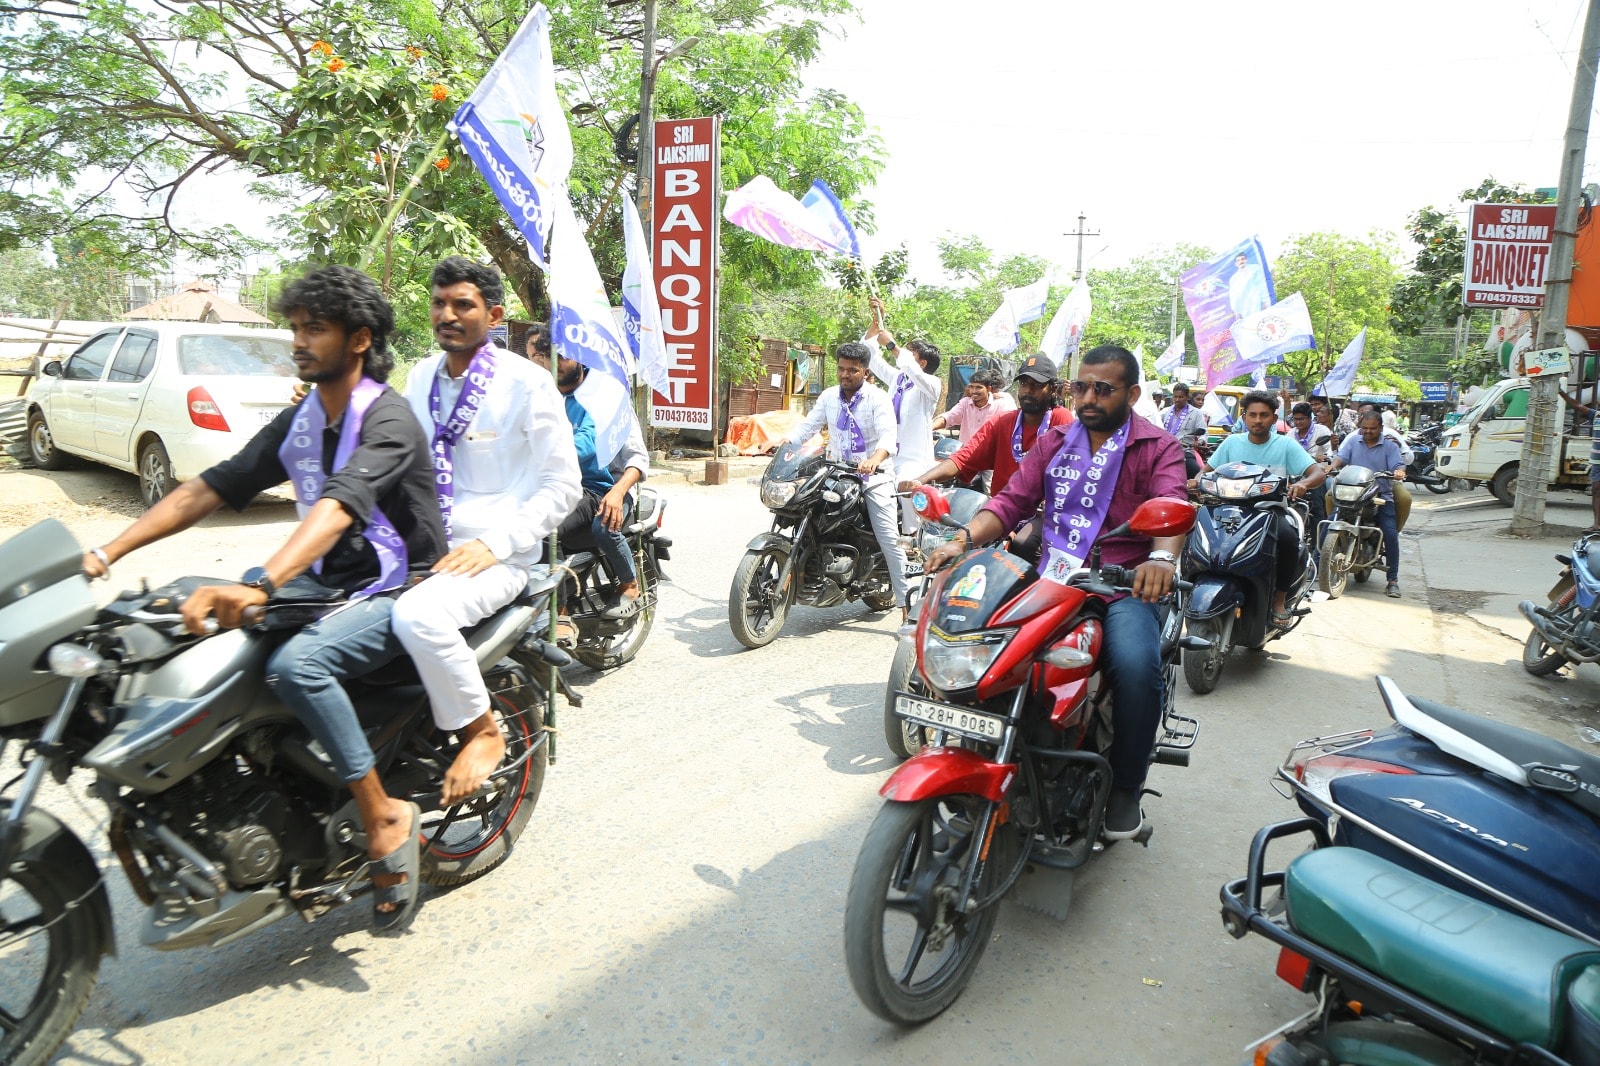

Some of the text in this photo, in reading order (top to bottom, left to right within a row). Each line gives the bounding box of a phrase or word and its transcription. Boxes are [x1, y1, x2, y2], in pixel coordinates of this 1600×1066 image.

[673, 125, 694, 144] SRI
[658, 144, 710, 165] LAKSHMI
[1500, 208, 1529, 224] SRI
[1477, 224, 1549, 241] LAKSHMI
[1471, 243, 1549, 290] BANQUET
[660, 169, 704, 404] BANQUET
[1475, 292, 1537, 304] 9704378333
[655, 408, 708, 424] 9704378333
